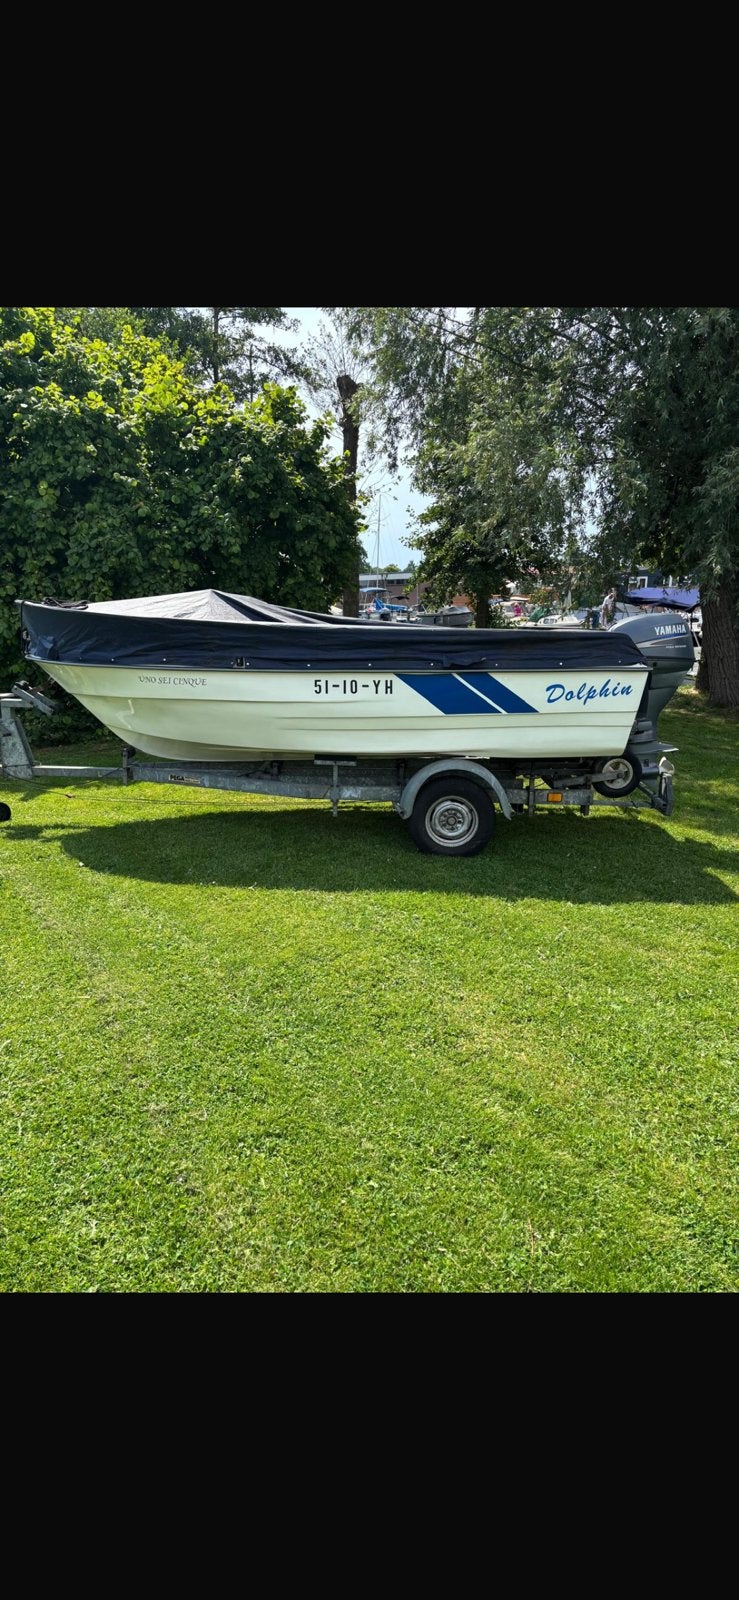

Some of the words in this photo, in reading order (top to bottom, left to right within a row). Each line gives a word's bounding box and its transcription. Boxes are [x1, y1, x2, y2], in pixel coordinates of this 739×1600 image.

[654, 624, 687, 636] YAMAHA
[138, 675, 157, 684] UNO
[157, 676, 171, 685] SEI
[173, 677, 208, 688] CINQUE
[314, 679, 393, 695] 51-10-YH
[545, 678, 633, 706] Dolphin
